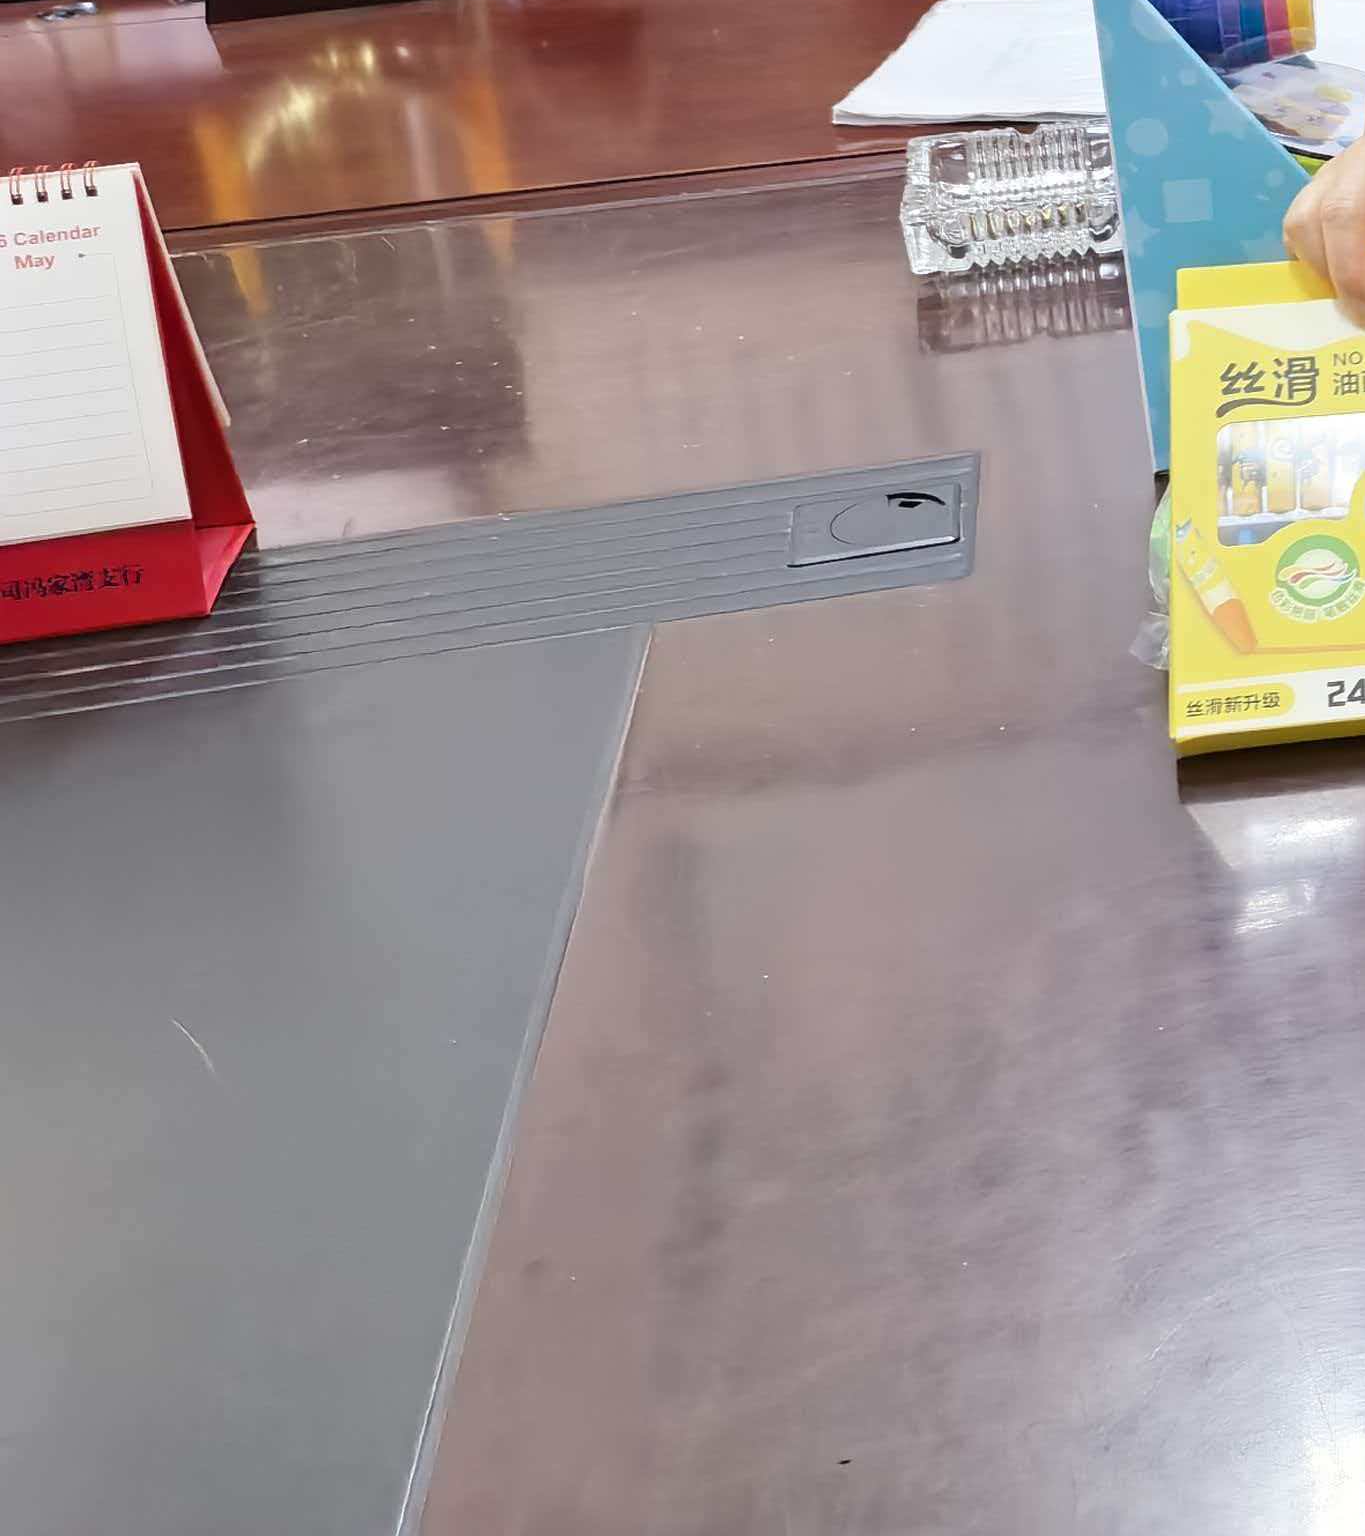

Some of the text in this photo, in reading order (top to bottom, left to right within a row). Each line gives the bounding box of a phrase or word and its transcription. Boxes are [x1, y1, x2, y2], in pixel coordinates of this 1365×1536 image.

[13, 224, 101, 246] Calendar
[14, 254, 56, 271] May
[1215, 356, 1320, 419] 丝滑
[1185, 691, 1282, 718] 丝滑新升级
